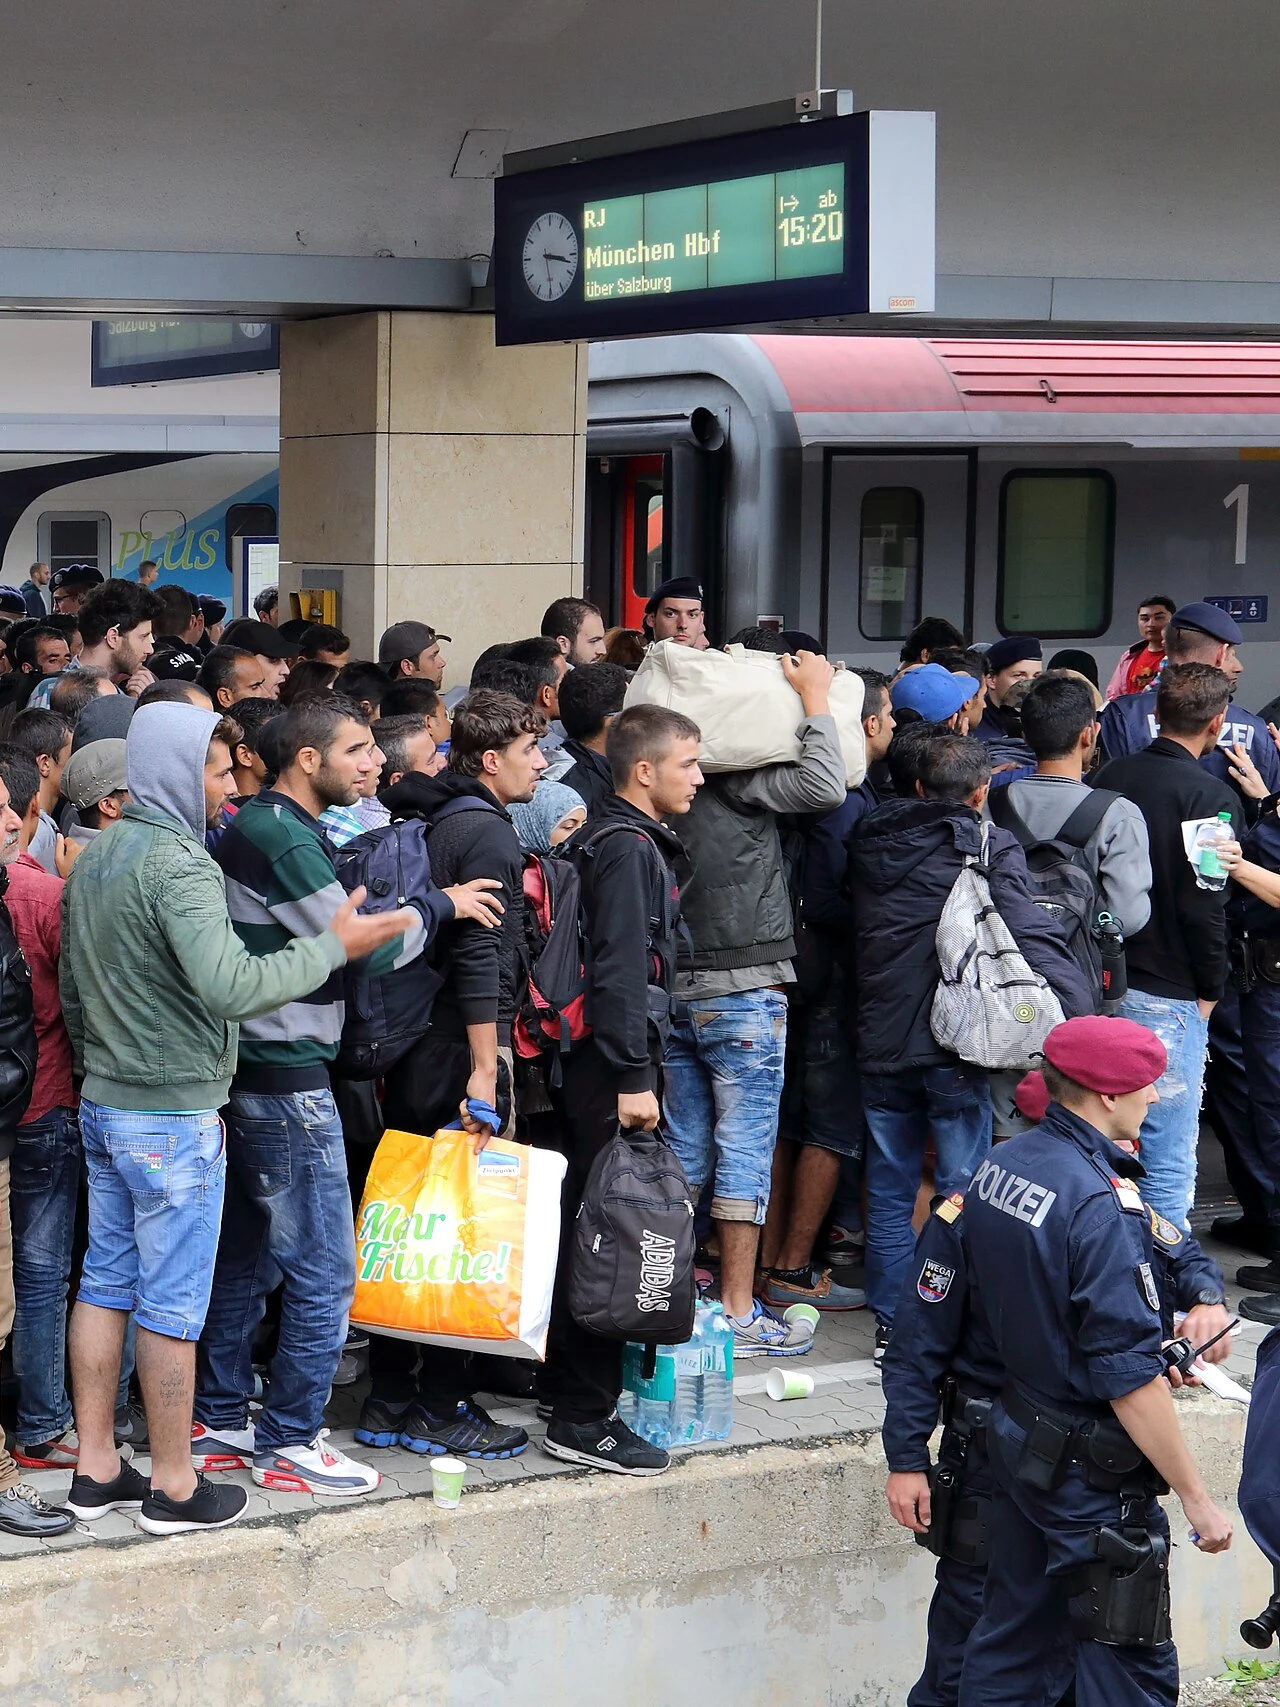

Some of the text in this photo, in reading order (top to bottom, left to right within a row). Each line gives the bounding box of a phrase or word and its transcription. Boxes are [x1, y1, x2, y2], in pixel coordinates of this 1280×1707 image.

[584, 208, 606, 229] RJ
[819, 190, 838, 209] ab
[778, 211, 843, 248] 15:20
[586, 230, 721, 270] München Hbf
[586, 274, 672, 299] über Salzburg
[889, 298, 915, 307] ascom
[1223, 483, 1250, 565] 1
[115, 528, 220, 572] PLUS
[967, 1159, 1058, 1228] POLIZEI
[360, 1241, 509, 1281] Frische!
[634, 1229, 676, 1313] ADIDAS
[927, 1261, 951, 1278] WEGA
